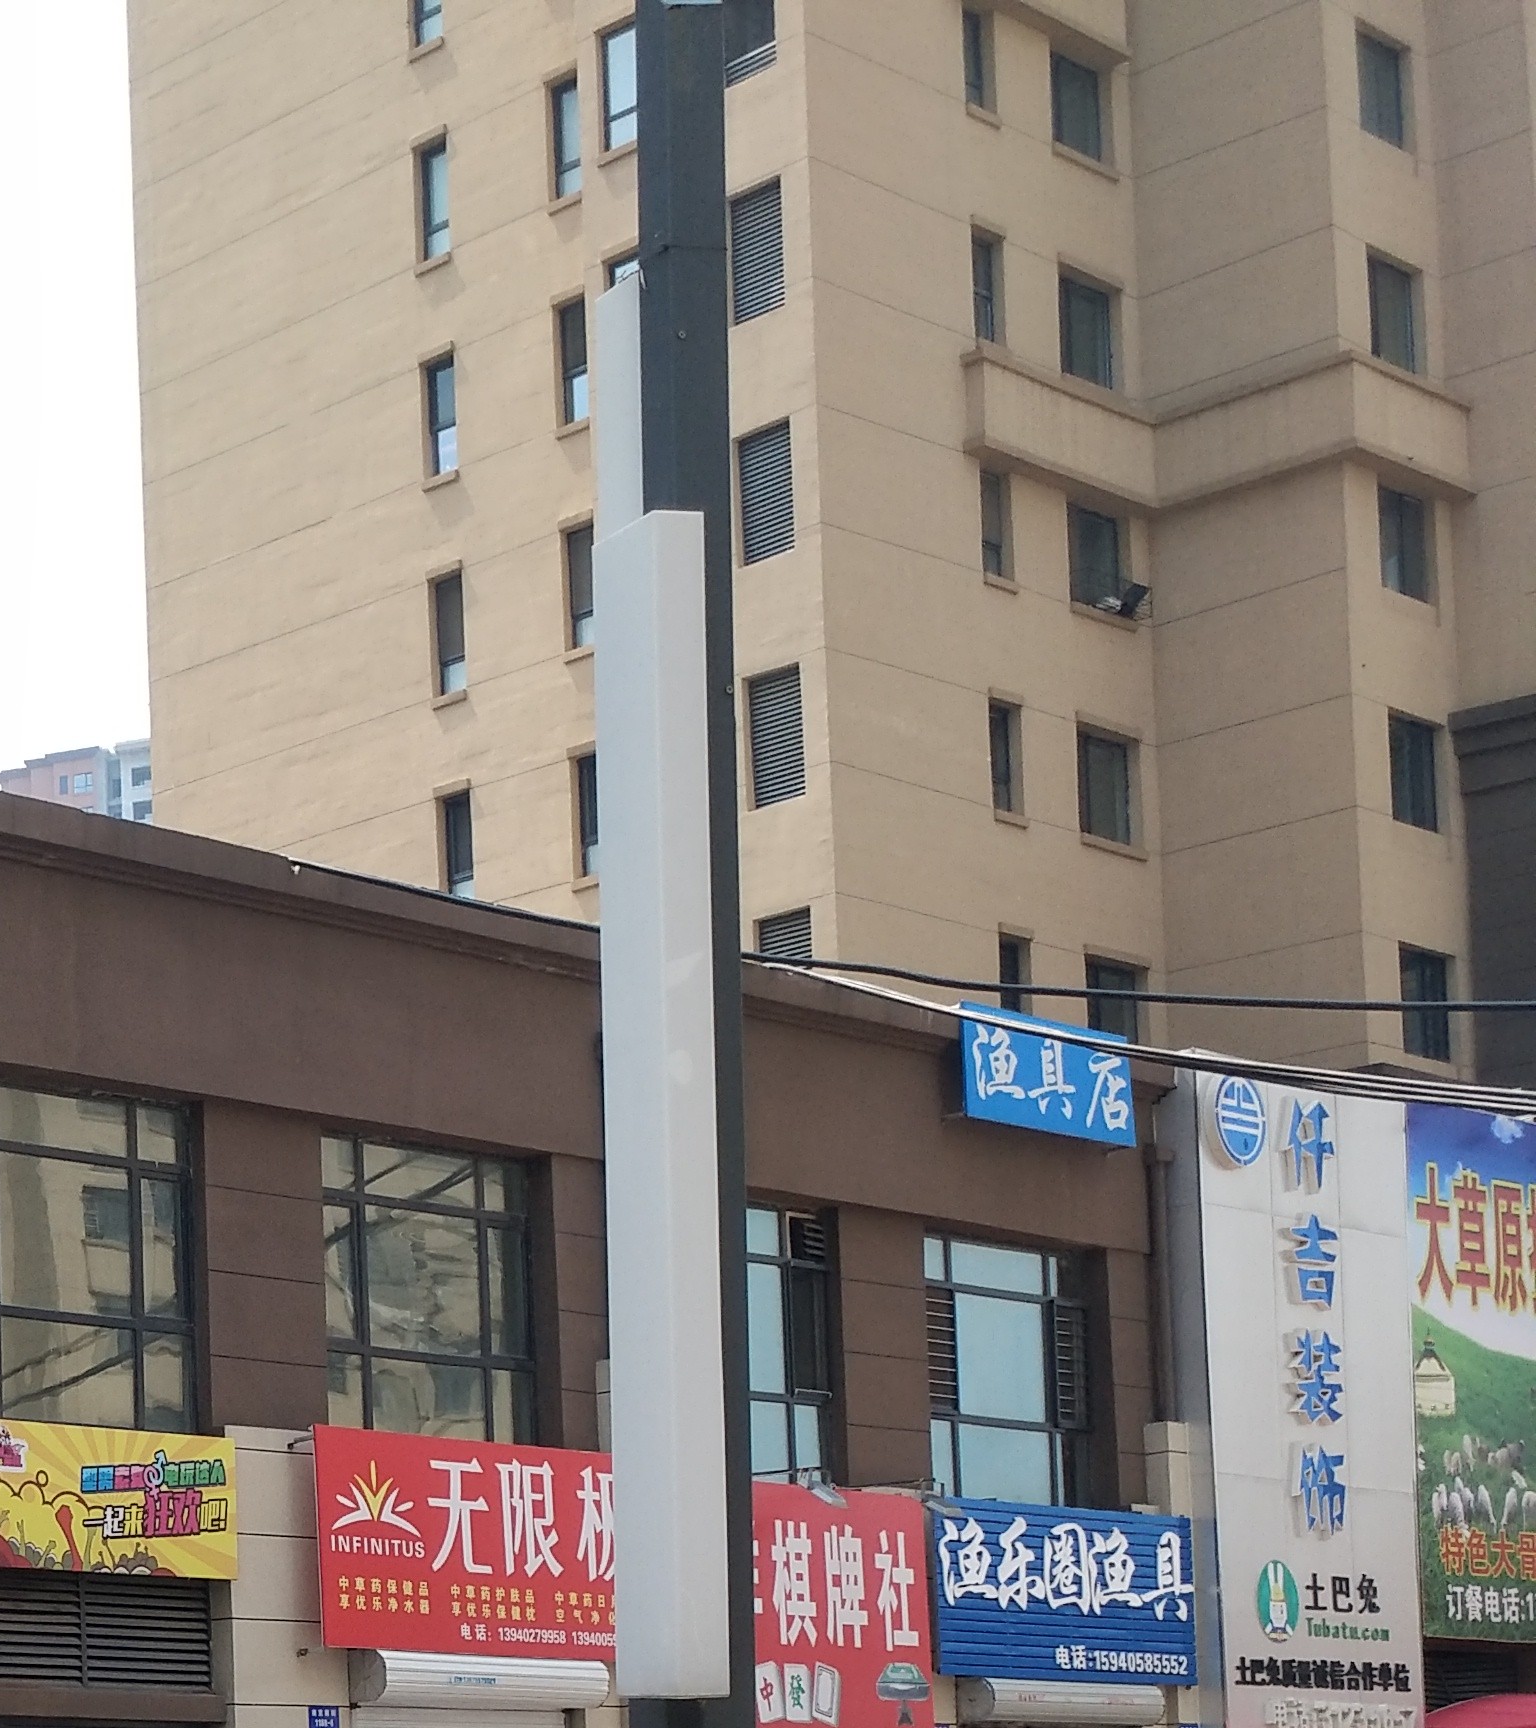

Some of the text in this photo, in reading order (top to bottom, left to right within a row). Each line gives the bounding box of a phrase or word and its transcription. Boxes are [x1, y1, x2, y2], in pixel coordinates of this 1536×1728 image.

[971, 1023, 1129, 1131] 渔具店
[1415, 1162, 1536, 1312] 大草原
[1285, 1097, 1348, 1536] 仟吉装饰
[330, 1534, 426, 1559] INFINITUS
[753, 1519, 920, 1652] 棋牌社
[938, 1516, 1194, 1622] 渔乐圈渔具
[338, 1575, 429, 1597] 中草药保健品
[554, 1590, 615, 1609] 中草药日
[1304, 1573, 1381, 1614] 土巴兔
[497, 1627, 567, 1645] 13940279958
[1305, 1617, 1390, 1641] Tubatu.com
[759, 1676, 774, 1712] 中
